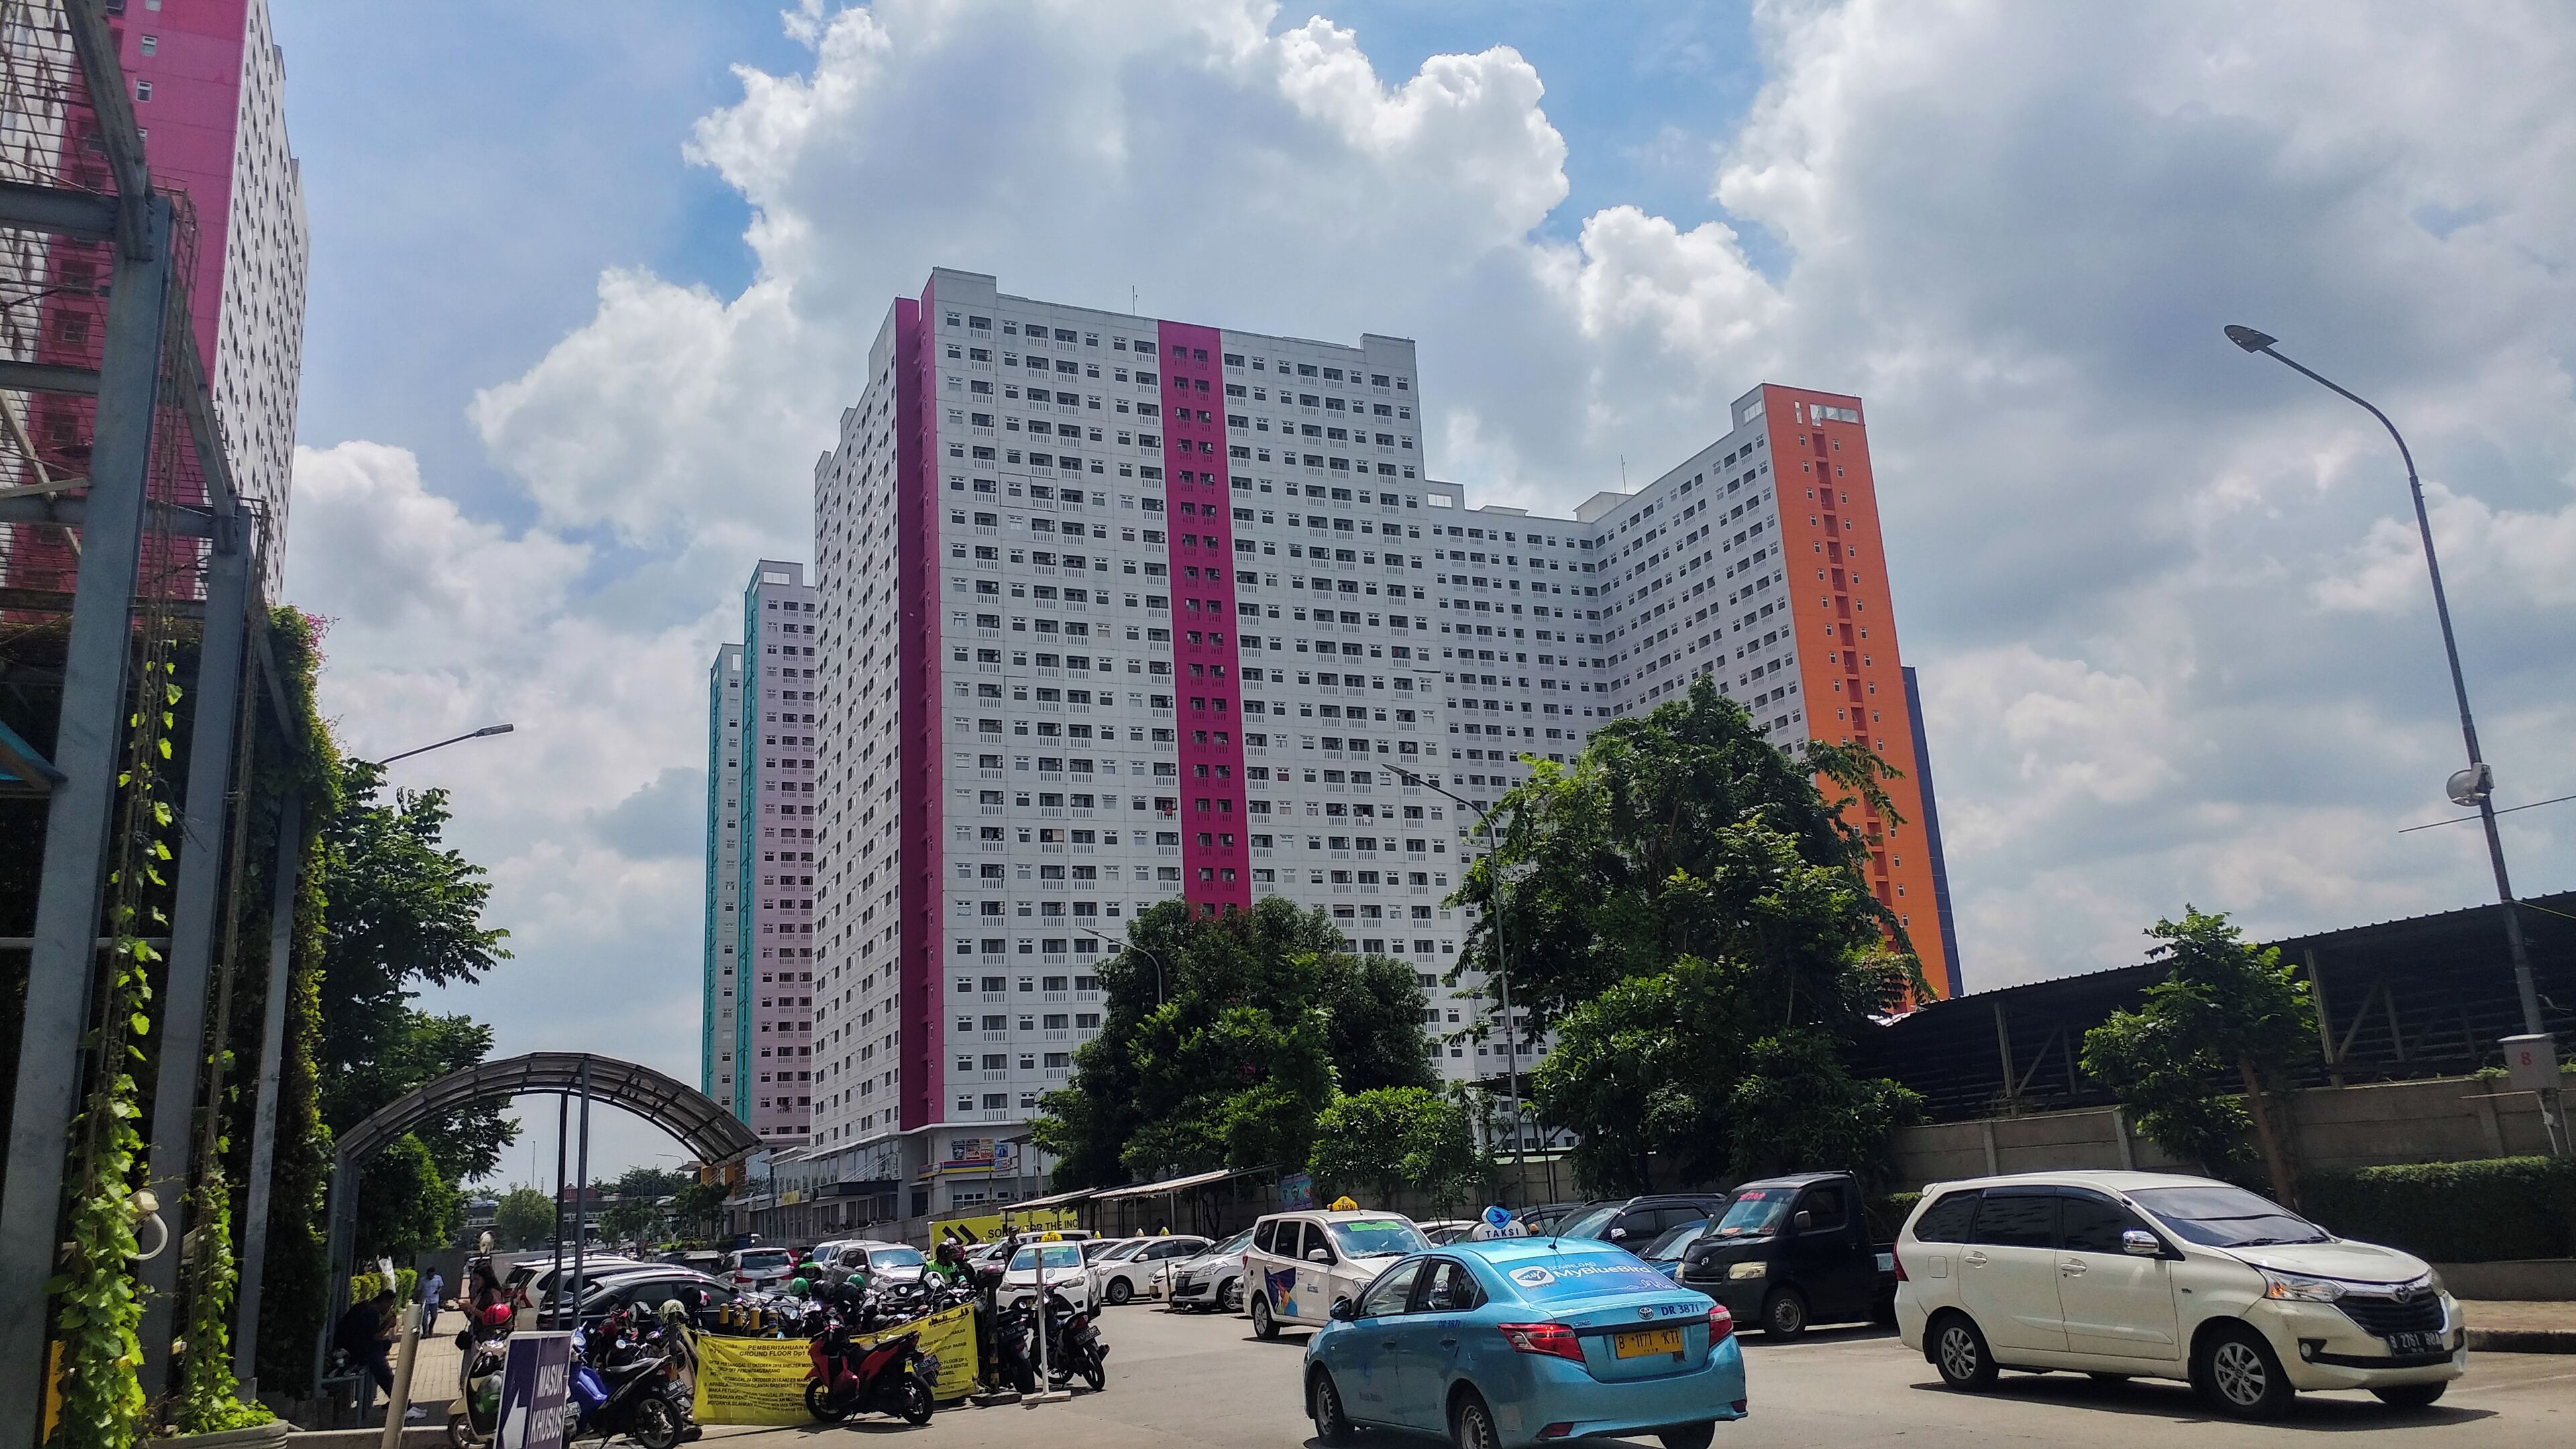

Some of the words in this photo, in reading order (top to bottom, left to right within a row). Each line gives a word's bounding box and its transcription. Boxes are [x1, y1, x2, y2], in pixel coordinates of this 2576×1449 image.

[2521, 1051, 2532, 1065] 8
[1045, 1220, 1063, 1231] THE
[1065, 1219, 1078, 1228] INC
[1485, 1228, 1519, 1238] TAKSI
[1548, 1261, 1597, 1271] DOWNLOAD
[1554, 1265, 1651, 1279] MyBlueBird
[1661, 1307, 1676, 1316] DR
[1679, 1303, 1700, 1314] 3871
[1618, 1336, 1625, 1350] B
[1635, 1333, 1652, 1348] 1171
[2400, 1333, 2420, 1348] 2761
[537, 1363, 566, 1398] MASUK
[529, 1405, 563, 1444] KHUSUS
